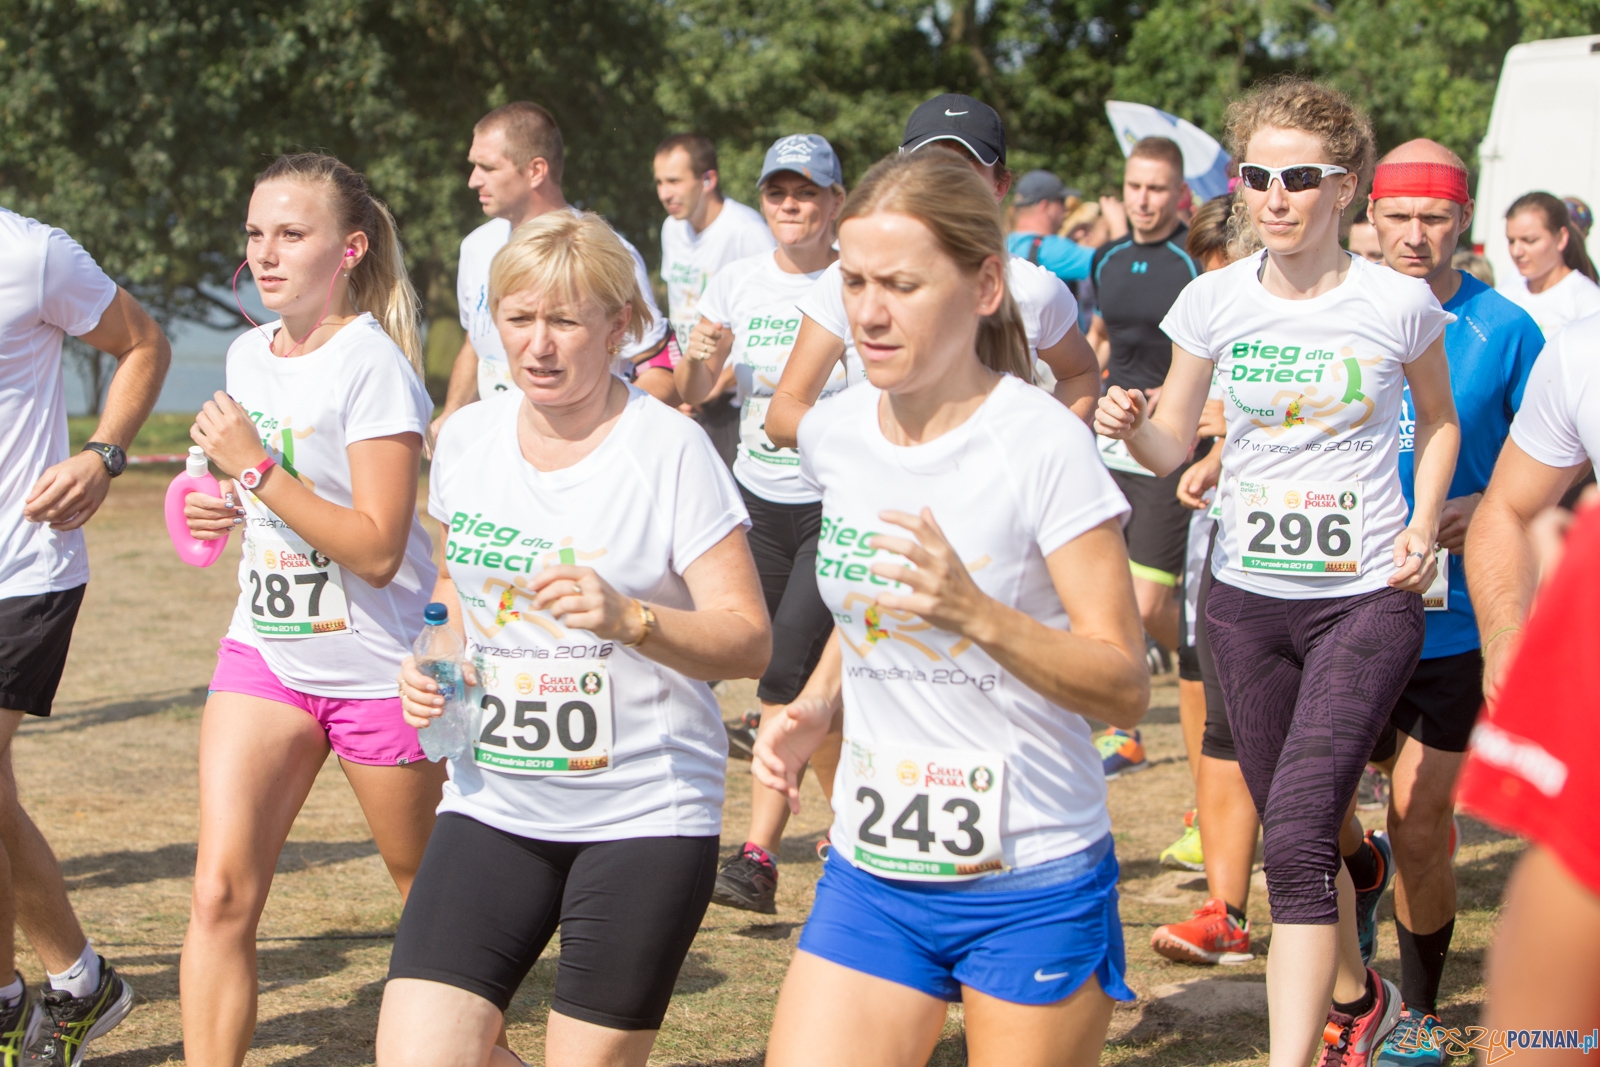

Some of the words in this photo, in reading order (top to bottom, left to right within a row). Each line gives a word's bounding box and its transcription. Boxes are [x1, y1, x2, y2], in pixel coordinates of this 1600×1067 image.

[748, 315, 800, 332] Bieg
[746, 332, 794, 348] Dzie
[1231, 340, 1301, 365] Bieg
[1305, 350, 1334, 360] dla
[1231, 363, 1326, 383] Dzieci
[1228, 386, 1275, 417] Roberta
[1233, 439, 1250, 450] 17
[1324, 440, 1374, 452] 2016
[450, 511, 521, 547] Bieg
[521, 537, 554, 549] dla
[1247, 511, 1351, 557] 296
[445, 540, 539, 573] Dzieci
[249, 569, 329, 618] 287
[554, 643, 614, 659] 2016
[479, 694, 598, 752] 250
[856, 786, 984, 857] 243
